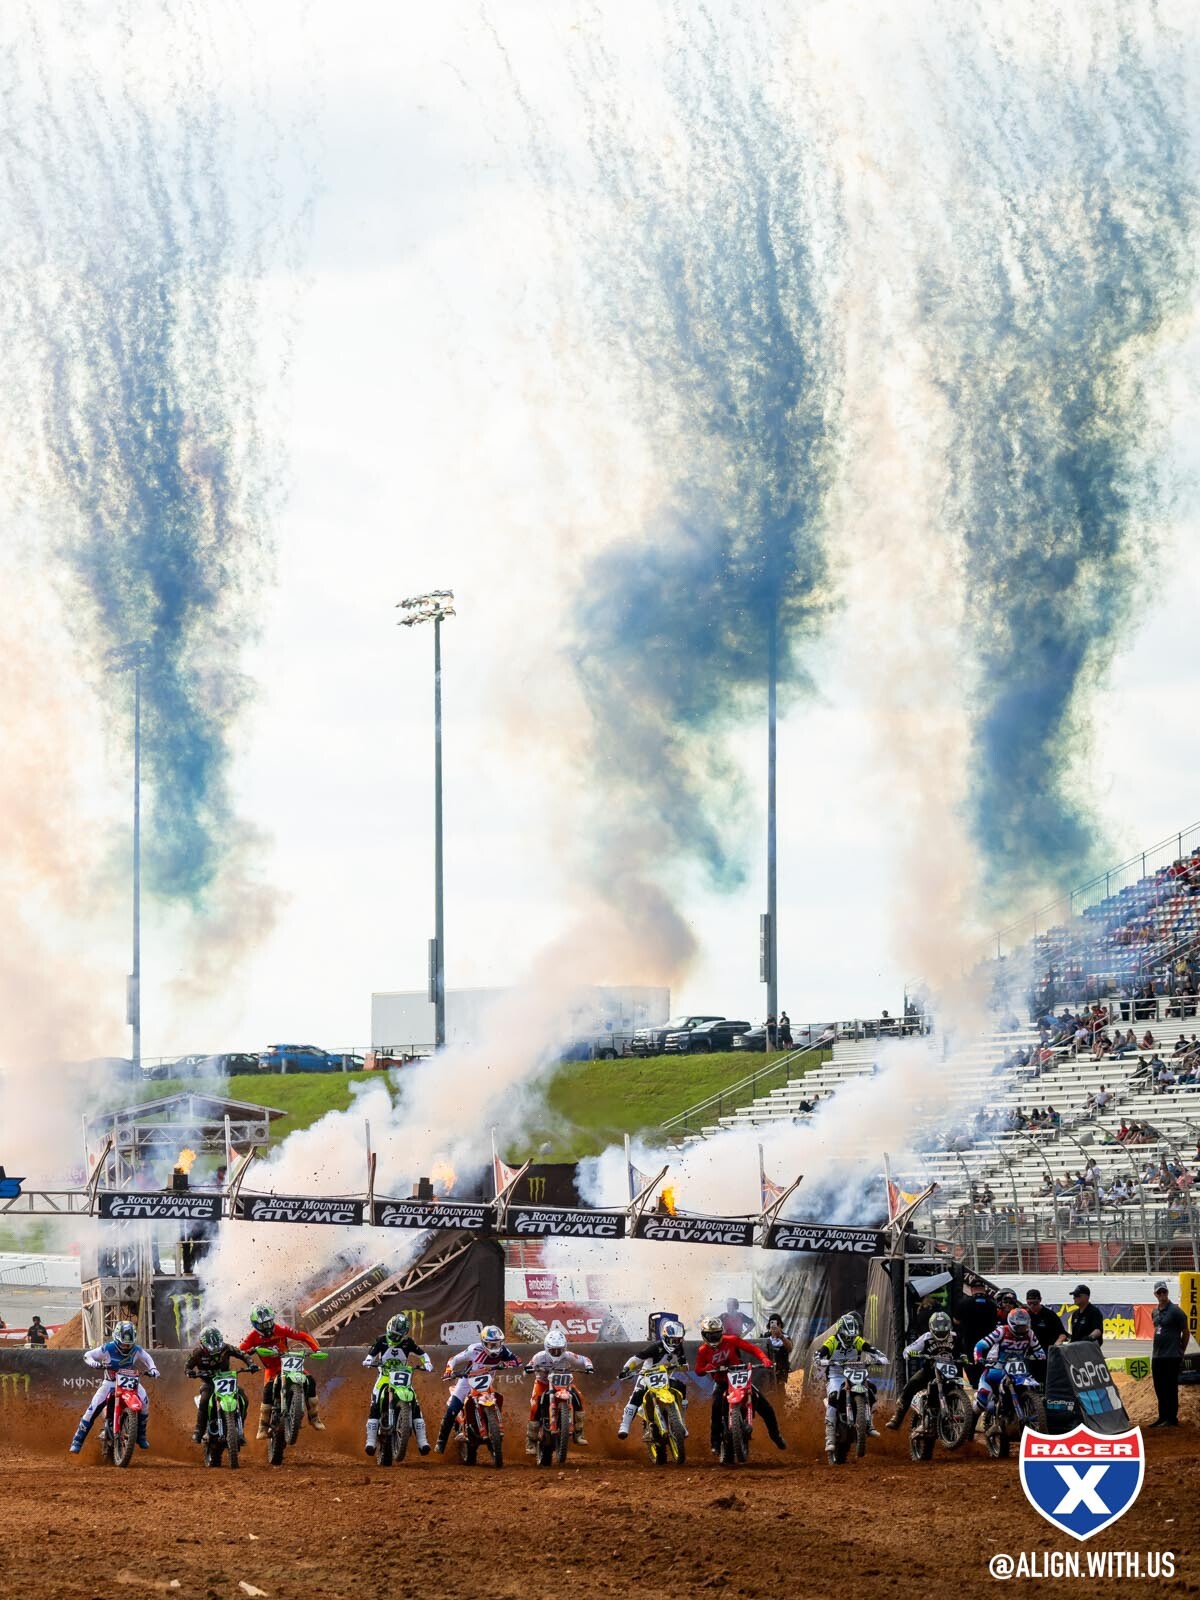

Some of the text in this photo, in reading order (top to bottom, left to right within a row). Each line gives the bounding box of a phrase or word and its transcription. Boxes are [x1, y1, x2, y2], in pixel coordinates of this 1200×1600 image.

[126, 1195, 213, 1206] ROCKY MOUNTAIN
[269, 1199, 355, 1211] ROCKY MOUNTAIN
[399, 1205, 484, 1216] ROCKY MOUNTAIN
[532, 1212, 617, 1224] ROCKY MOUNTAIN
[661, 1218, 746, 1232] ROCKY MOUNTAIN
[792, 1228, 877, 1241] ROCKY MOUNTAIN
[322, 1279, 372, 1314] MONSTER
[712, 1350, 730, 1362] FLY
[284, 1358, 303, 1370] 47
[940, 1364, 956, 1375] 46
[1008, 1363, 1025, 1374] 44
[393, 1372, 410, 1386] 9
[552, 1375, 571, 1386] 80
[650, 1374, 667, 1386] 94
[732, 1372, 748, 1384] 15
[1070, 1362, 1110, 1387] GoPro
[63, 1376, 100, 1389] MONS
[120, 1376, 138, 1390] 23
[216, 1380, 236, 1393] 21
[474, 1376, 489, 1389] 2
